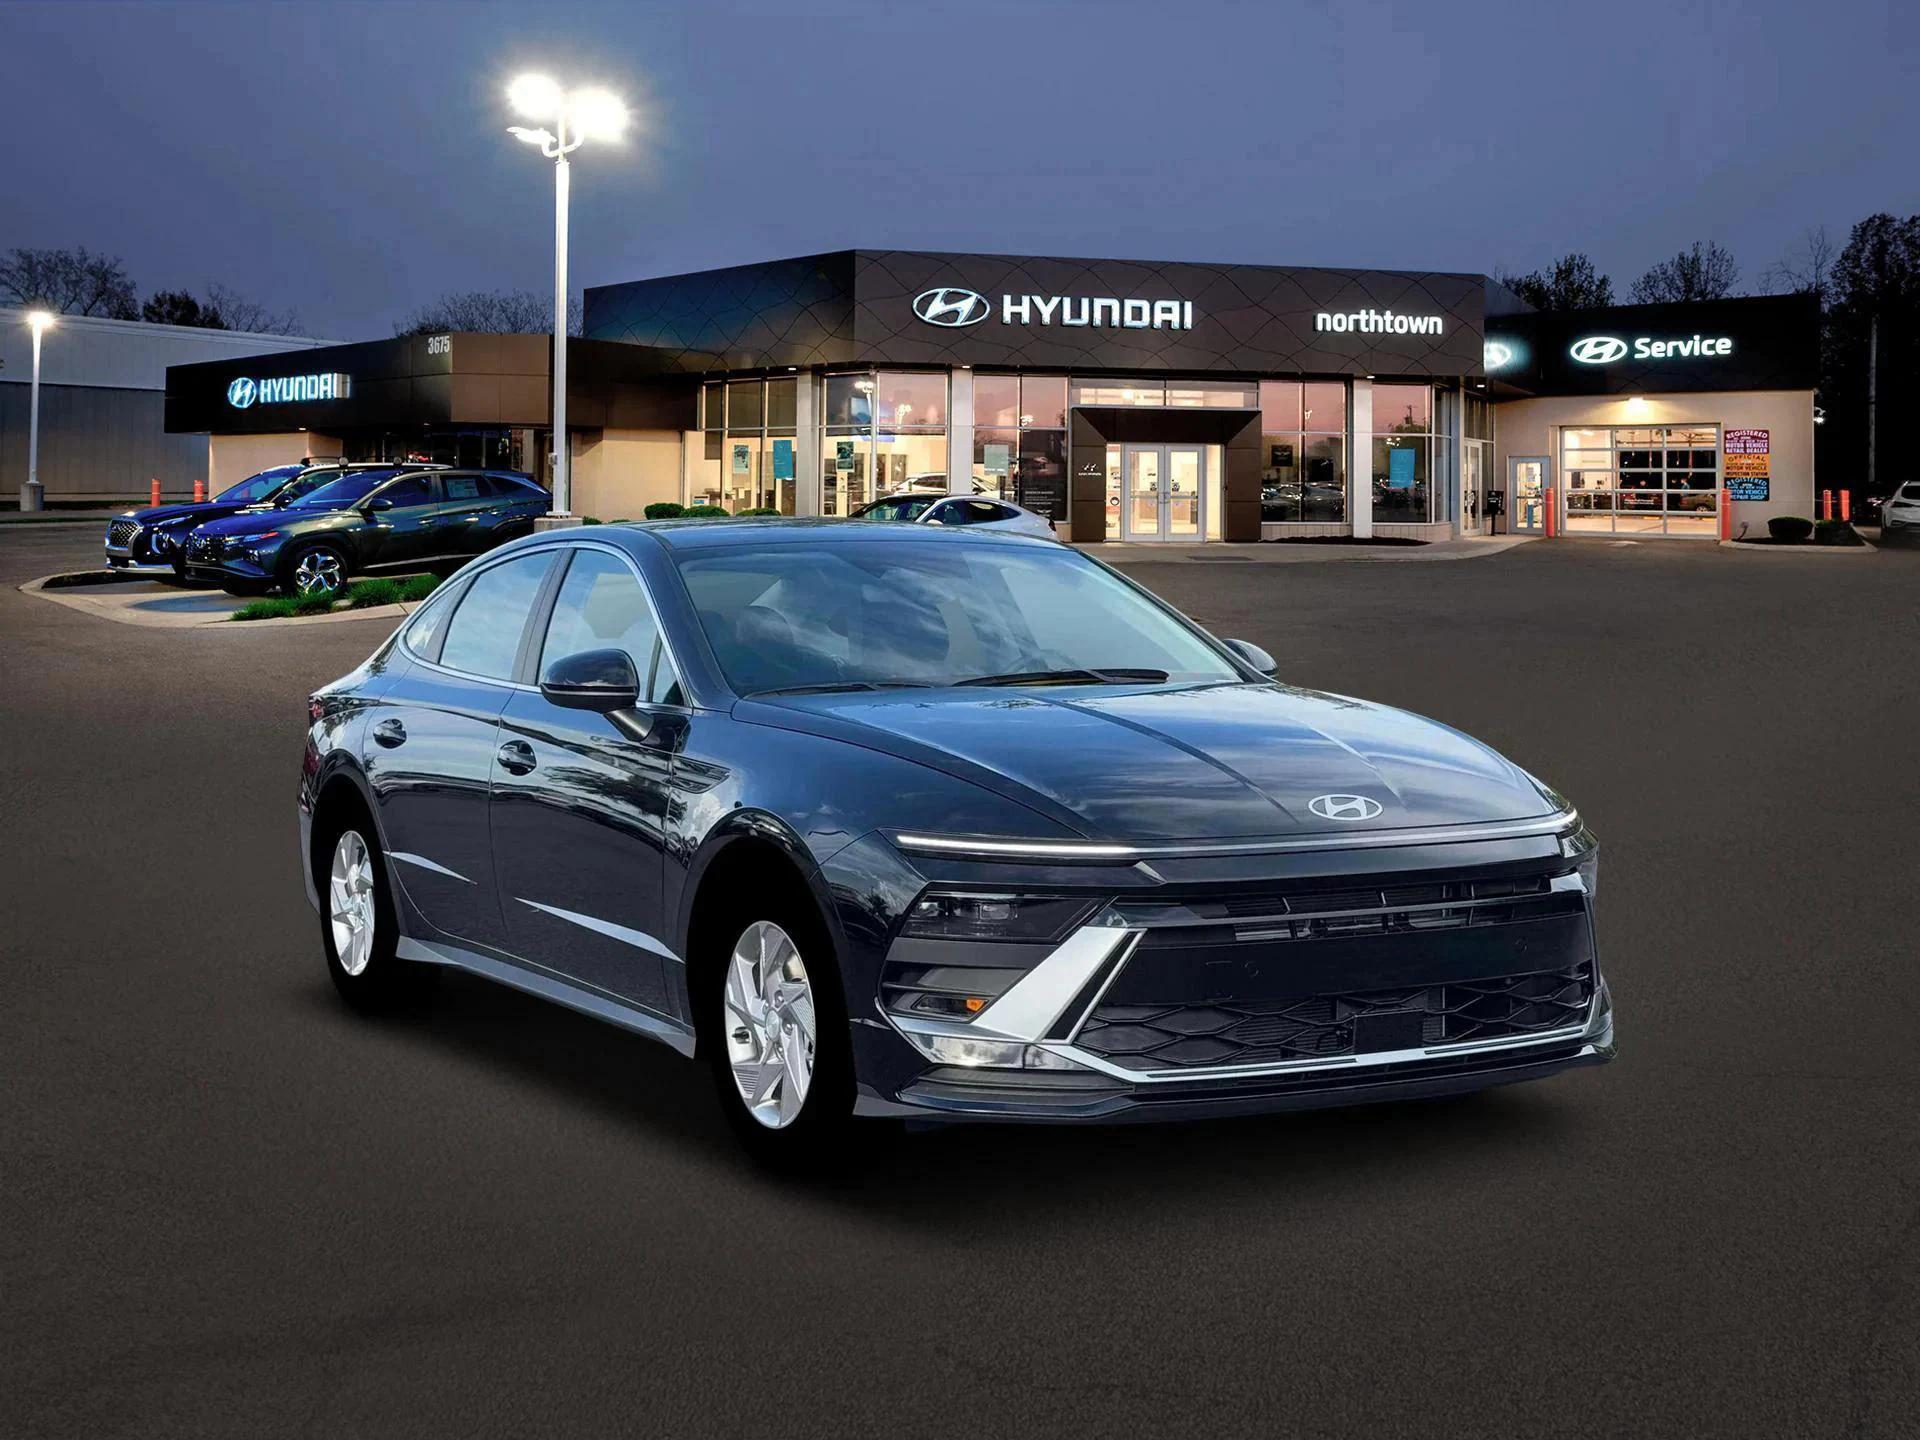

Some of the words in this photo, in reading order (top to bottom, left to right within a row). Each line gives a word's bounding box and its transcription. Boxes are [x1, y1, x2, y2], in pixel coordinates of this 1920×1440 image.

[1002, 294, 1193, 330] HYUNDAI
[1316, 308, 1443, 335] northtown
[428, 335, 450, 354] 3675
[1633, 334, 1733, 359] Service
[260, 373, 340, 403] HYUNDAI
[1726, 430, 1768, 439] REGISTERED
[1728, 454, 1766, 462] OFFICIAL
[1726, 478, 1767, 486] REGISTERED
